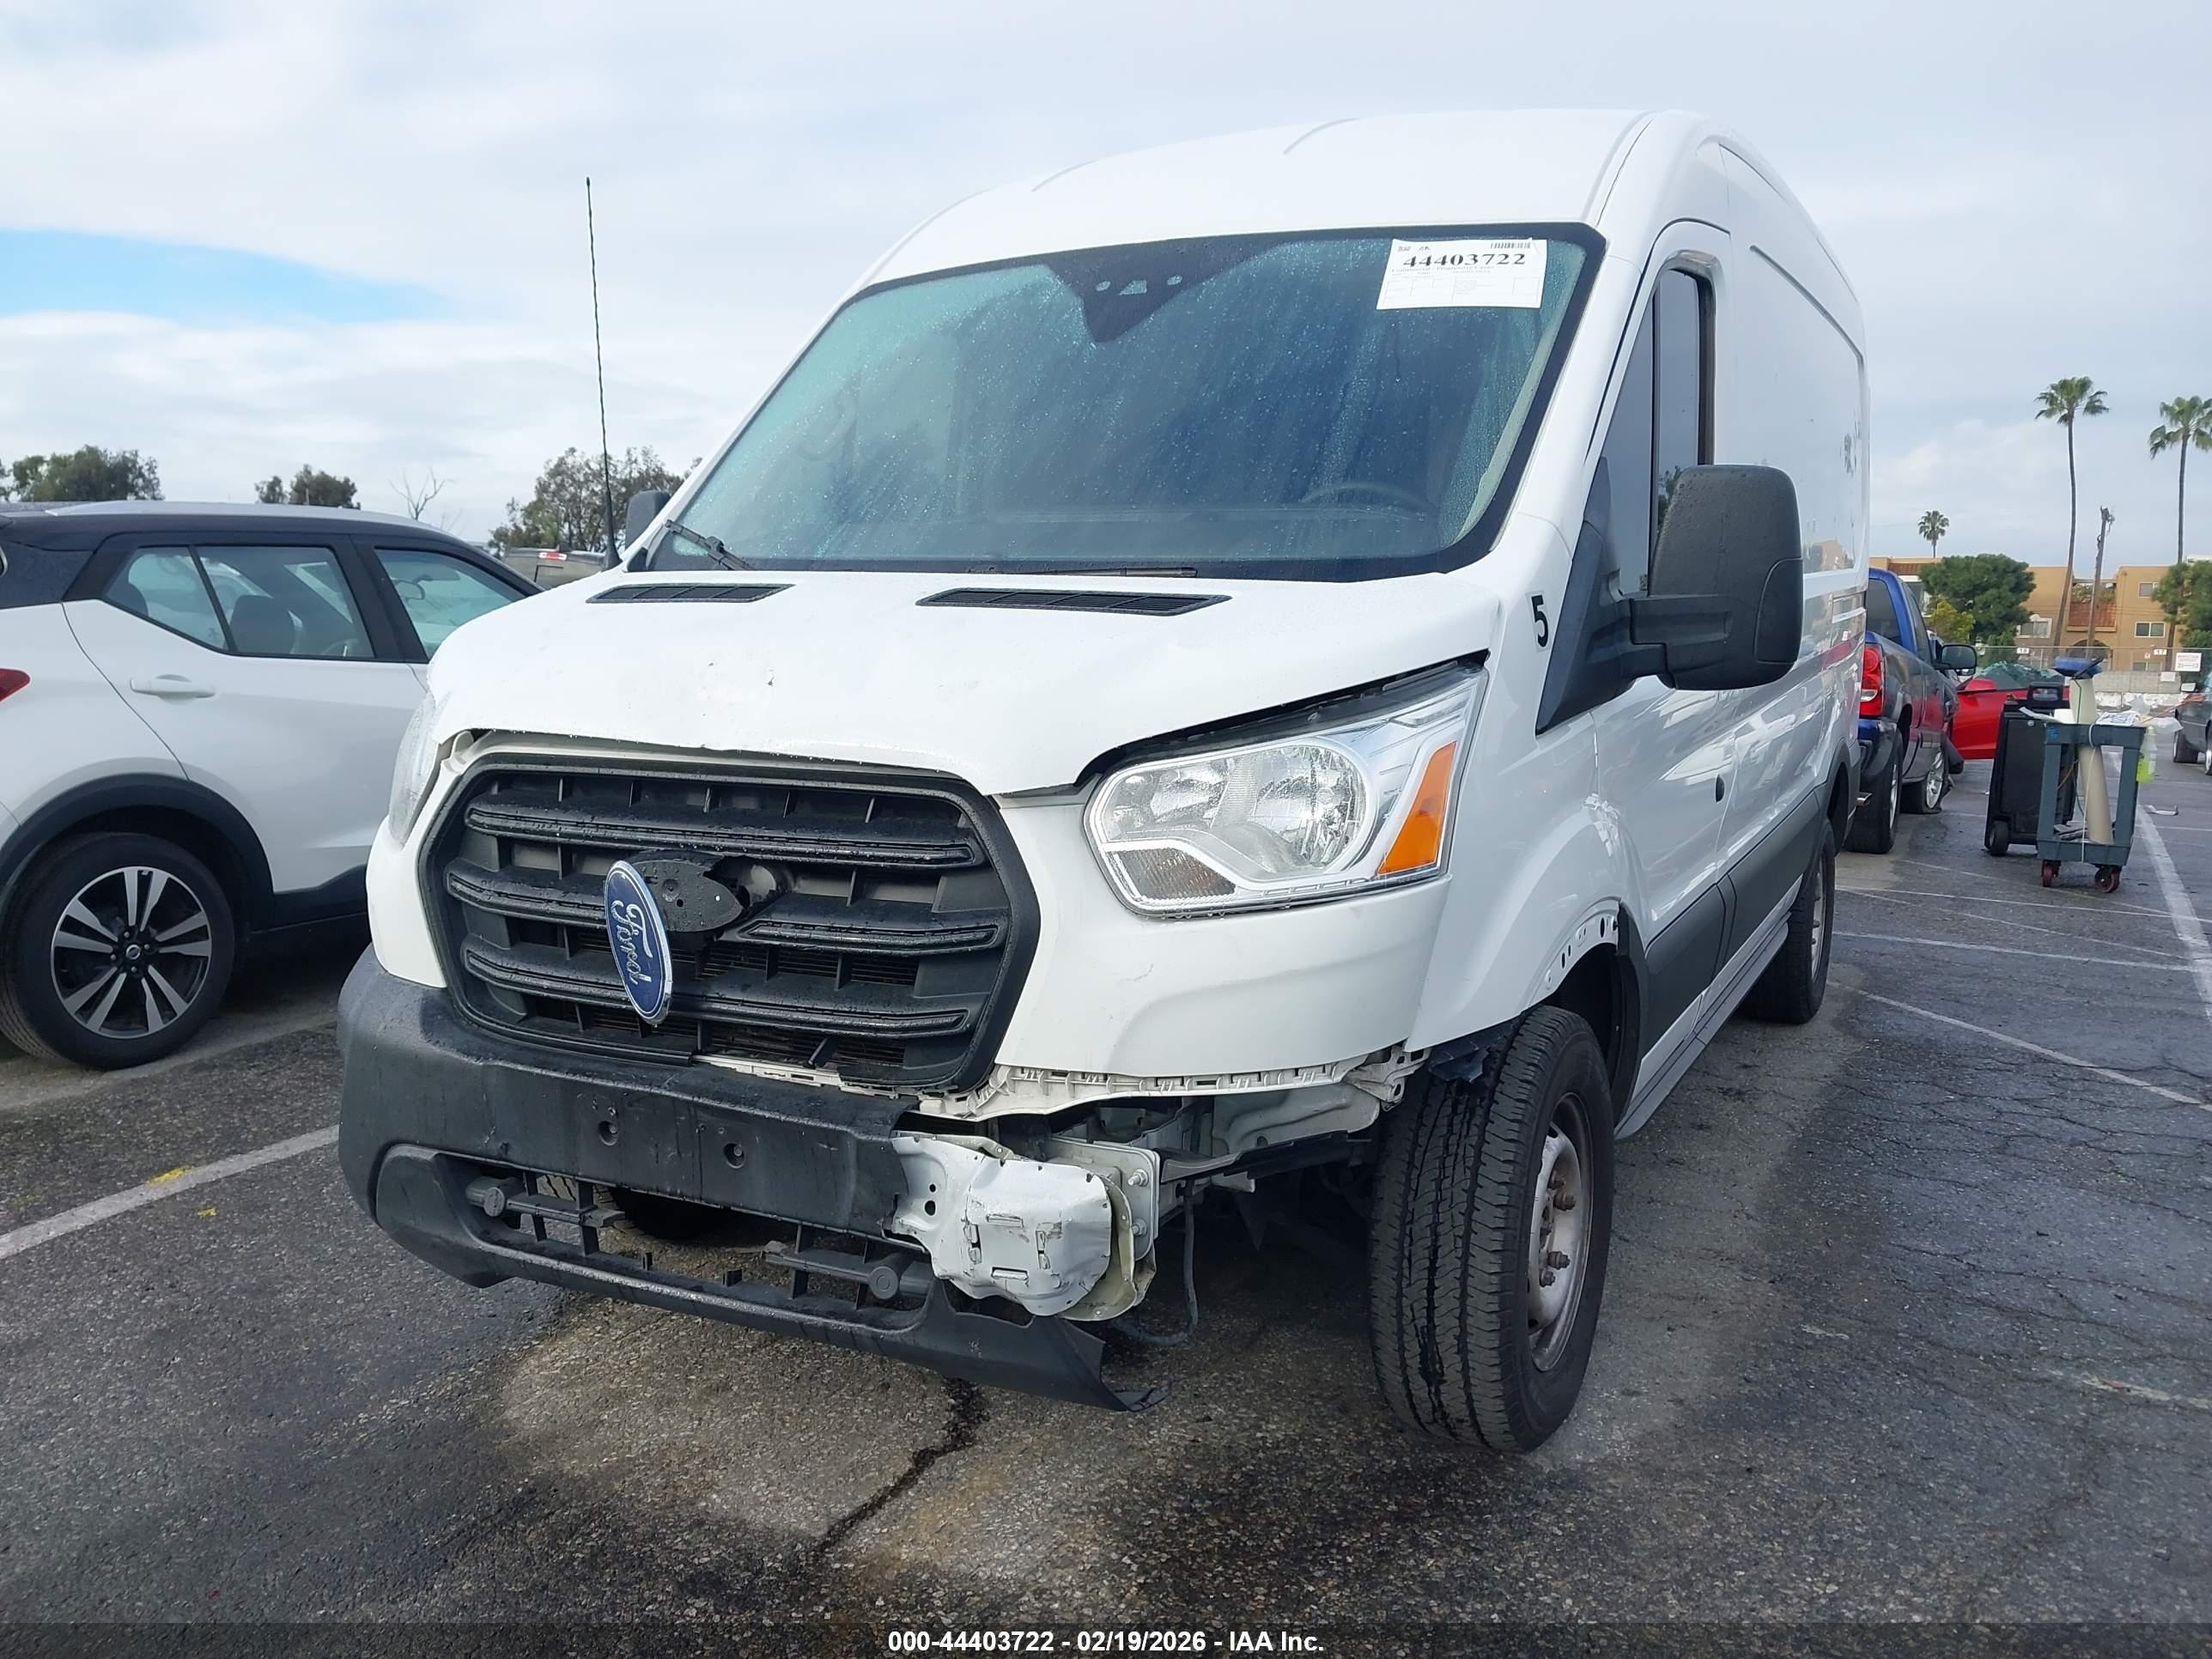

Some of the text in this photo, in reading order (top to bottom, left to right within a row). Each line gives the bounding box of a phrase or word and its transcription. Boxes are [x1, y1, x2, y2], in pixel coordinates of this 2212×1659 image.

[1403, 253, 1526, 268] 44403722
[1531, 594, 1549, 647] 5
[611, 899, 653, 986] Ford
